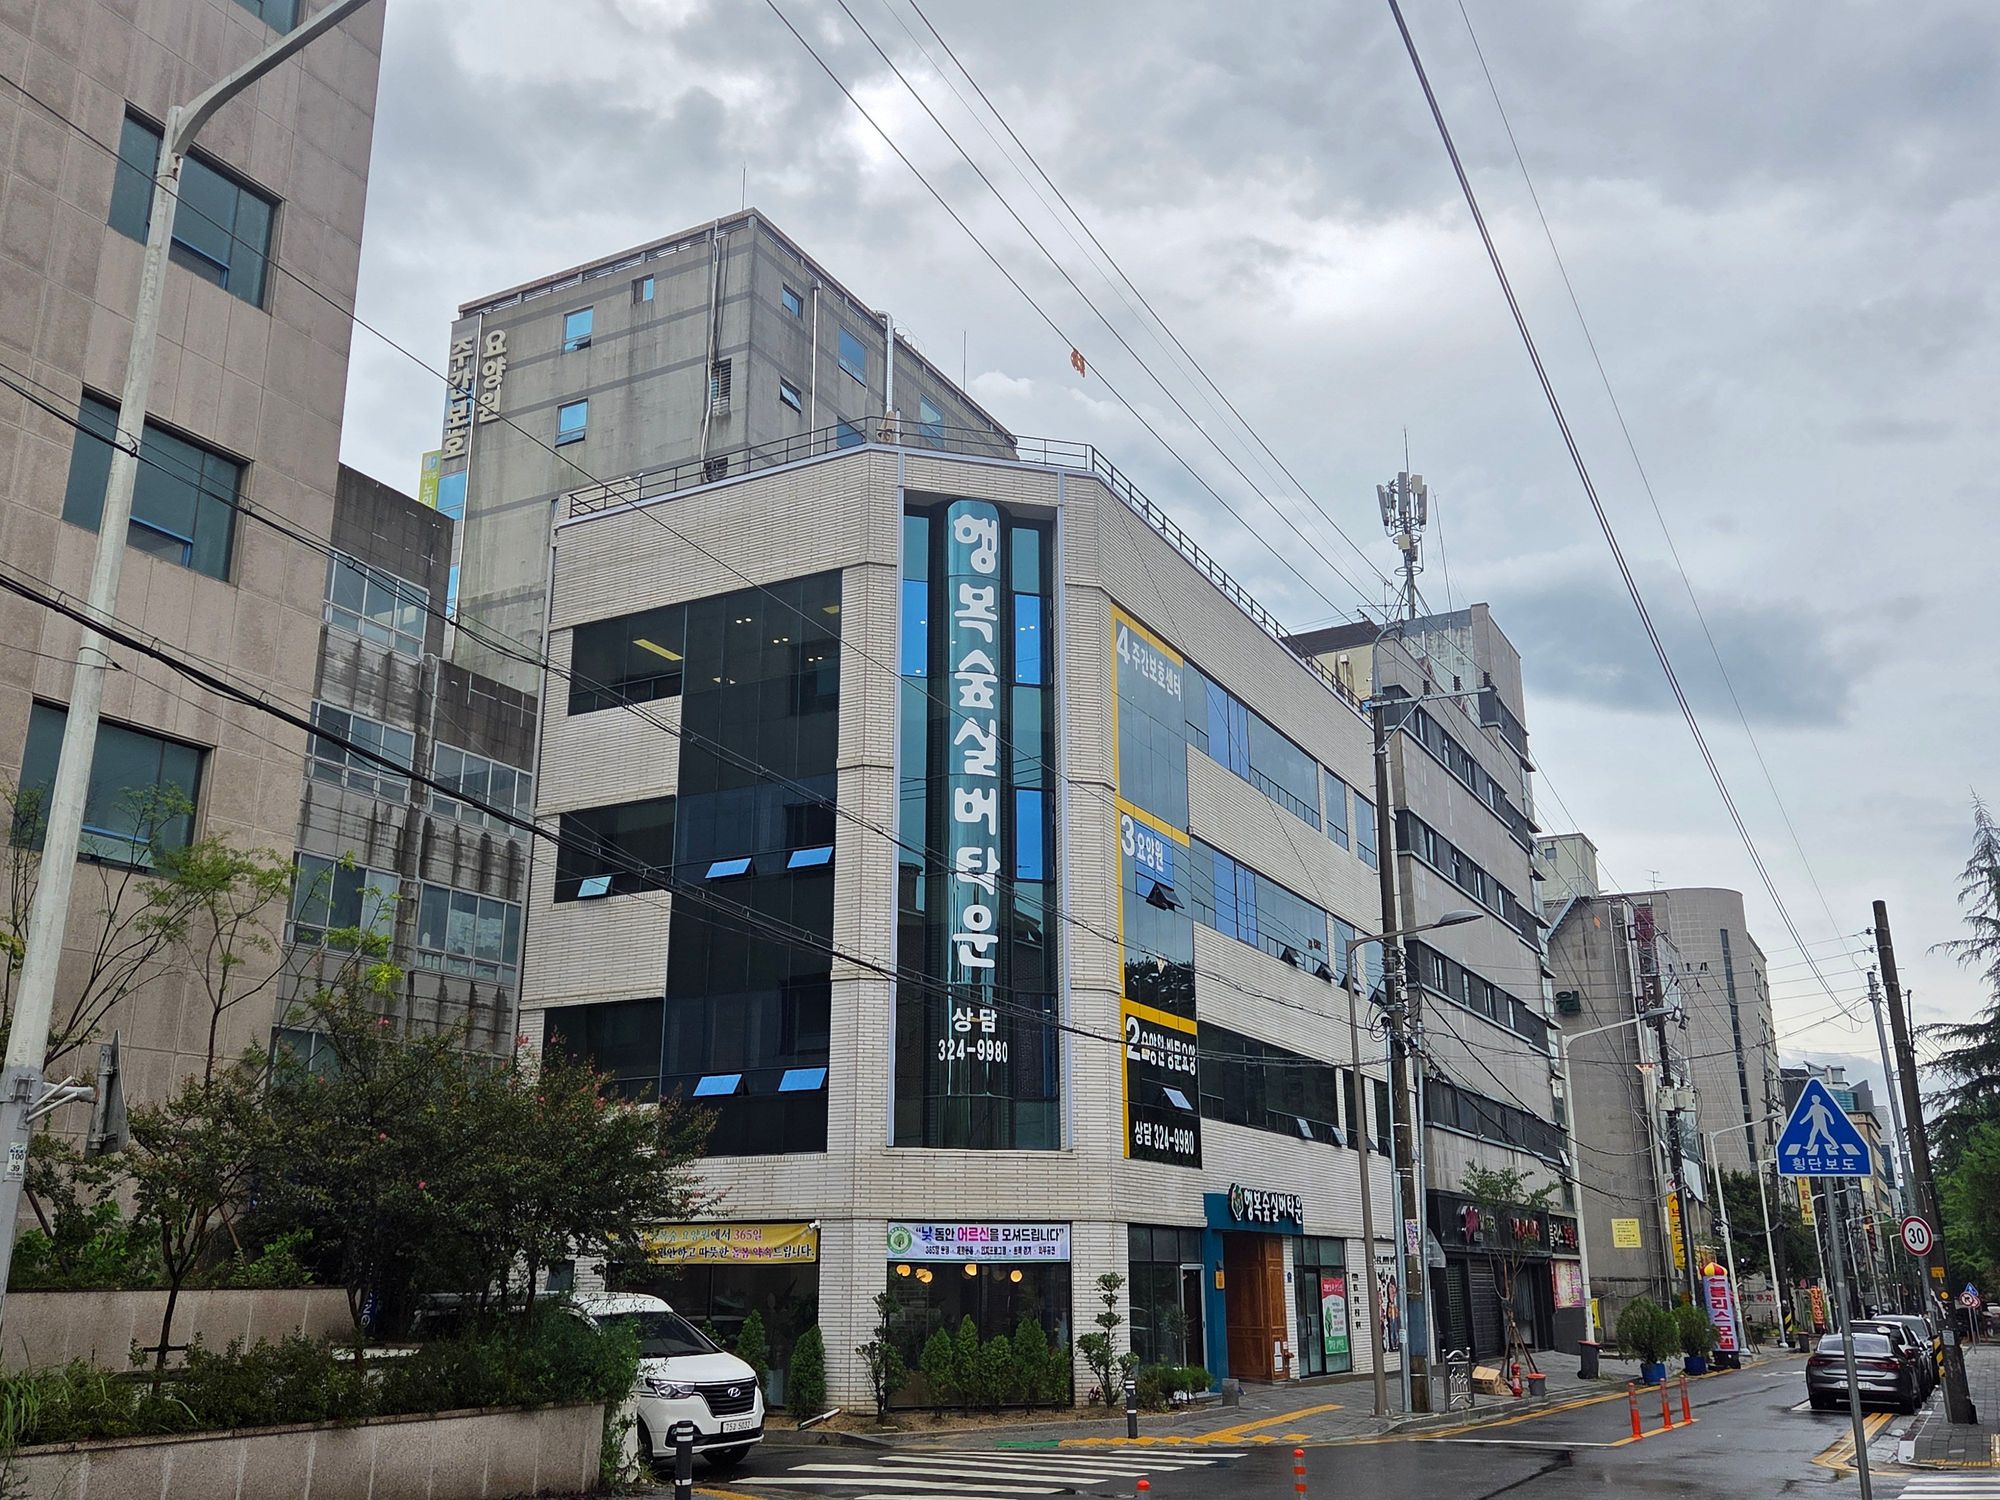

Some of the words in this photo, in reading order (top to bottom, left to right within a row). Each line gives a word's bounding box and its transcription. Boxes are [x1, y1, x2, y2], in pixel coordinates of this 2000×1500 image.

[477, 329, 507, 424] 요양원
[442, 336, 474, 460] 주간보호
[1116, 625, 1131, 665] 4
[1131, 641, 1182, 702] 주간보호센터
[953, 513, 1000, 969] 행복숲실버타운
[1121, 814, 1135, 857] 3
[1136, 832, 1164, 872] 요양원
[952, 1006, 998, 1033] 상담
[937, 1039, 1008, 1064] 324-9980
[1126, 1016, 1141, 1061] 2
[1134, 1120, 1152, 1147] 상담
[1154, 1123, 1195, 1156] 324-9980
[10, 1164, 21, 1172] 39
[11, 1153, 24, 1161] 100
[1792, 1157, 1857, 1171] 횡단보도
[1243, 1188, 1303, 1225] 행복숲실버타운
[681, 1228, 732, 1242] 요양원에서
[734, 1228, 763, 1242] 365일
[957, 1226, 999, 1242] 어르신을
[1908, 1227, 1925, 1245] 30
[699, 1246, 730, 1259] 따뜻한
